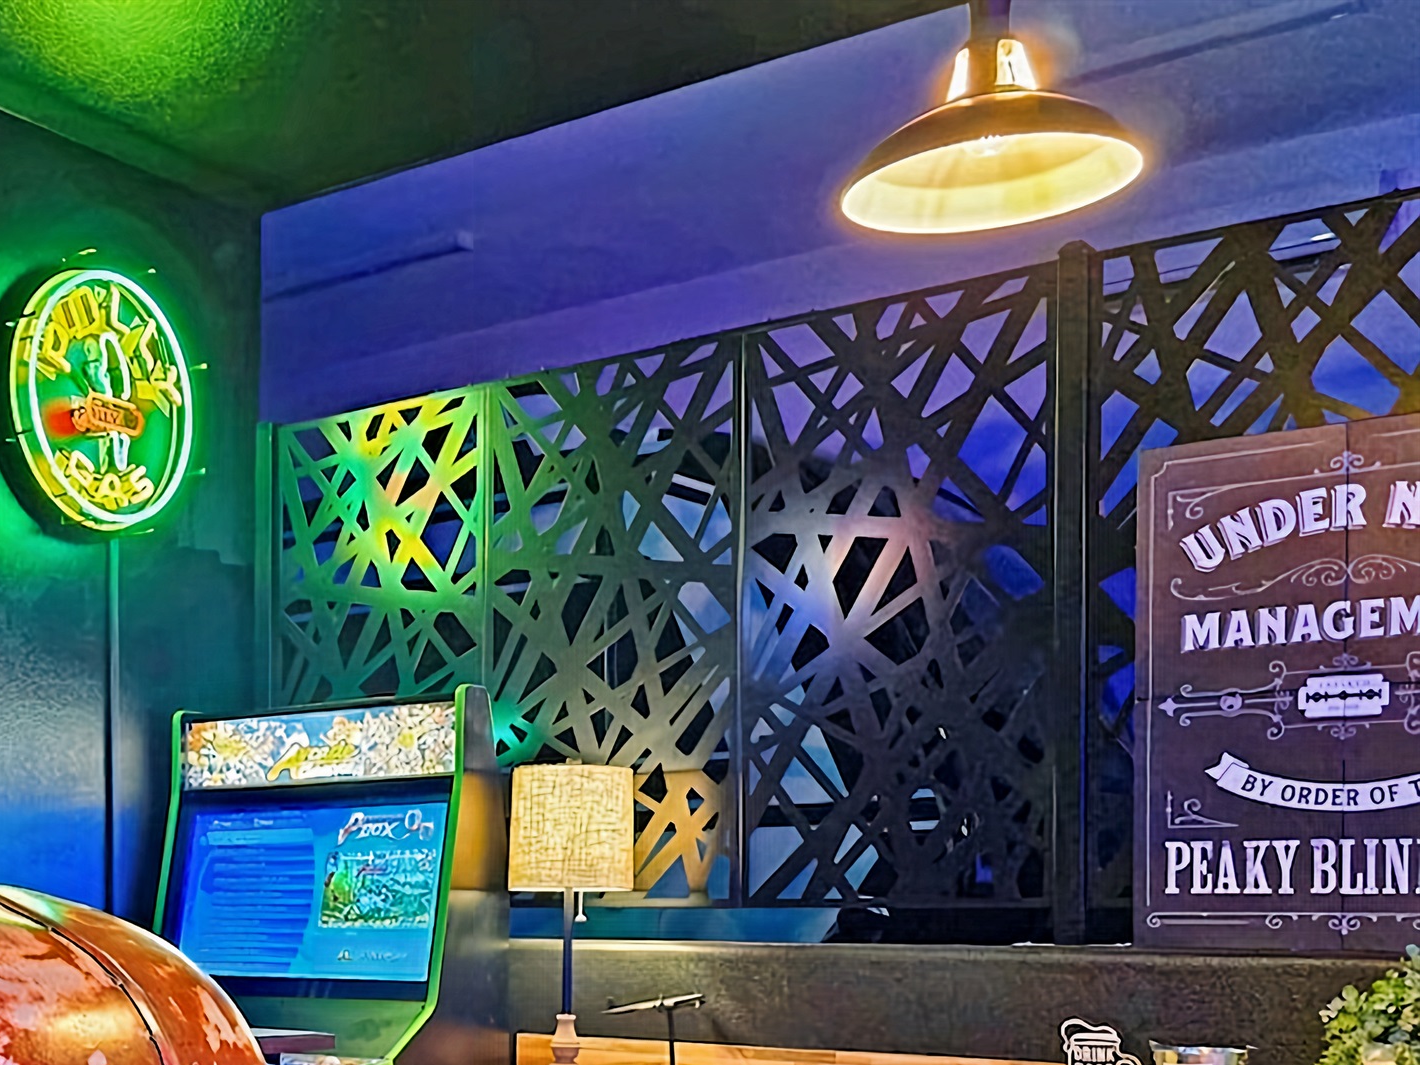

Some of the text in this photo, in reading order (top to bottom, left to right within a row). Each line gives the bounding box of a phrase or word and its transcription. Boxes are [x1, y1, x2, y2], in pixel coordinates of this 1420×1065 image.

[1179, 483, 1367, 573] UNDER
[1182, 595, 1420, 653] MANAGEM
[1240, 773, 1274, 797] BY
[1280, 784, 1360, 807] ORDER
[1369, 783, 1399, 805] OF
[1164, 838, 1420, 895] PEAKY BLIN
[1074, 1046, 1115, 1062] DRINK
